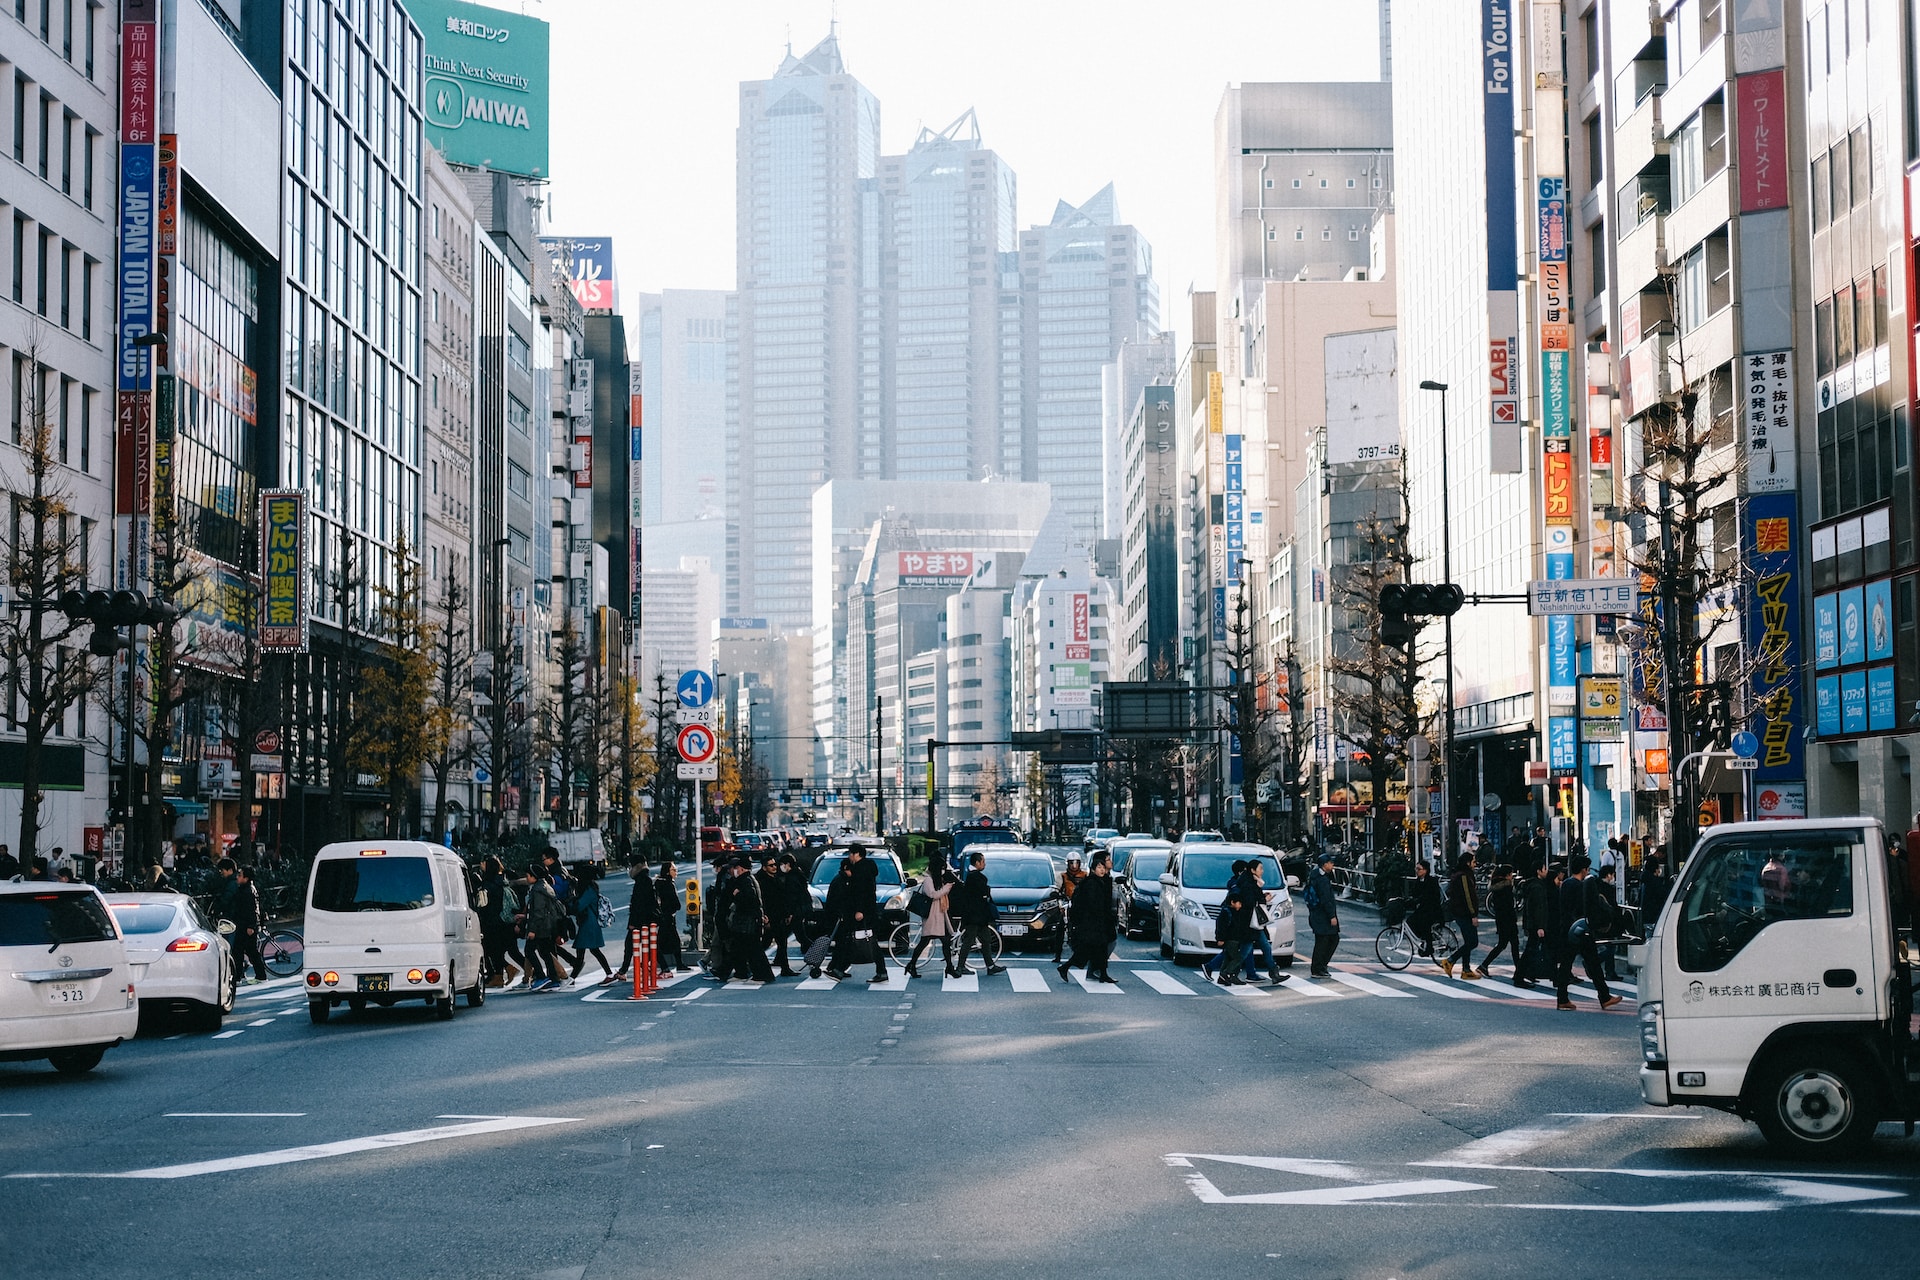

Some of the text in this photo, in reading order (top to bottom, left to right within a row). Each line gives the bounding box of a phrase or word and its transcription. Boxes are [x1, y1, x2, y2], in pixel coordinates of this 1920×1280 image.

[446, 16, 510, 42] 美和ロック
[1486, 6, 1509, 94] For Your
[130, 26, 148, 127] 品川美容外科
[425, 54, 529, 89] Think Next Security
[465, 96, 530, 130] MIWA
[129, 129, 148, 141] 6F
[1754, 97, 1770, 194] ワールドメイト
[1539, 178, 1563, 199] 6F
[1757, 197, 1771, 207] 6F
[125, 184, 149, 254] JAPAN
[123, 258, 148, 320] TOTAL
[1547, 338, 1562, 348] 5F
[1490, 340, 1508, 395] LABI
[1508, 358, 1517, 395] SHINJUKU
[1750, 355, 1767, 450] 本気の発毛治療
[1771, 353, 1788, 427] 薄毛・抜け毛
[1546, 440, 1567, 452] 3F
[1597, 437, 1606, 463] アイフル
[1548, 455, 1568, 514] トレカ
[1757, 519, 1788, 551] 薬
[270, 501, 295, 624] まんが喫茶
[903, 554, 968, 574] やまや
[1537, 587, 1631, 603] 西新宿1丁目
[1540, 602, 1628, 613] Nishishinjuku 1-chome
[1819, 609, 1832, 627] Tax
[1819, 627, 1835, 645] Free
[1757, 572, 1793, 767] マツモトキヨシ
[1551, 692, 1574, 701] 1F/2F
[1843, 687, 1866, 701] ソフマップ
[1553, 725, 1564, 768] アイ眼科
[1563, 719, 1574, 764] 新宿南口
[680, 767, 714, 776] ここまで
[1708, 985, 1756, 998] 株式会社
